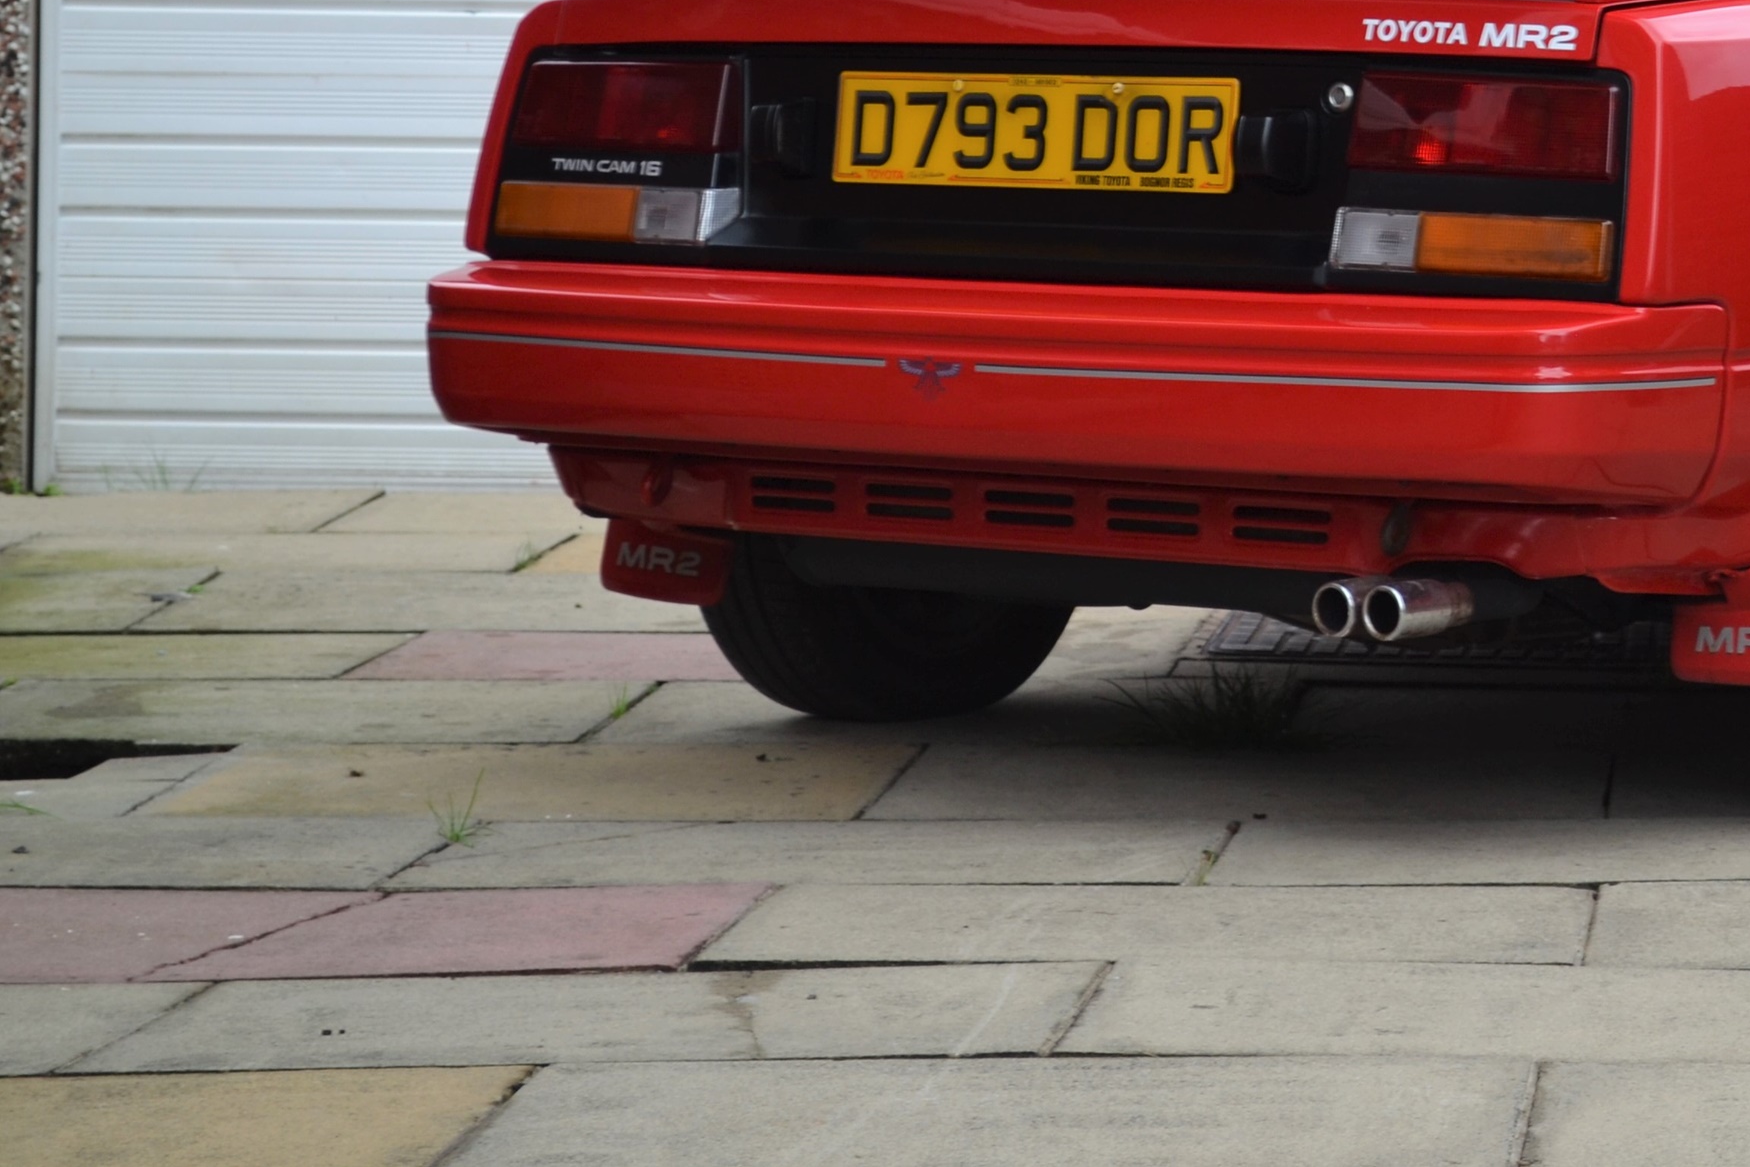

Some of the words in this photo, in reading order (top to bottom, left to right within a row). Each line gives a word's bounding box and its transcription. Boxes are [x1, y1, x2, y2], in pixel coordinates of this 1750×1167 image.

[1362, 18, 1468, 45] TOYOTA
[1478, 22, 1579, 51] MR2
[851, 89, 1048, 172] D793
[1072, 94, 1224, 174] DOR
[551, 157, 595, 172] TWIN
[596, 159, 637, 173] CAM
[639, 160, 663, 176] 16
[866, 169, 904, 180] TOYOTA
[1103, 175, 1131, 187] TOYOTA
[1171, 177, 1195, 189] REGIS
[616, 541, 702, 577] MR2
